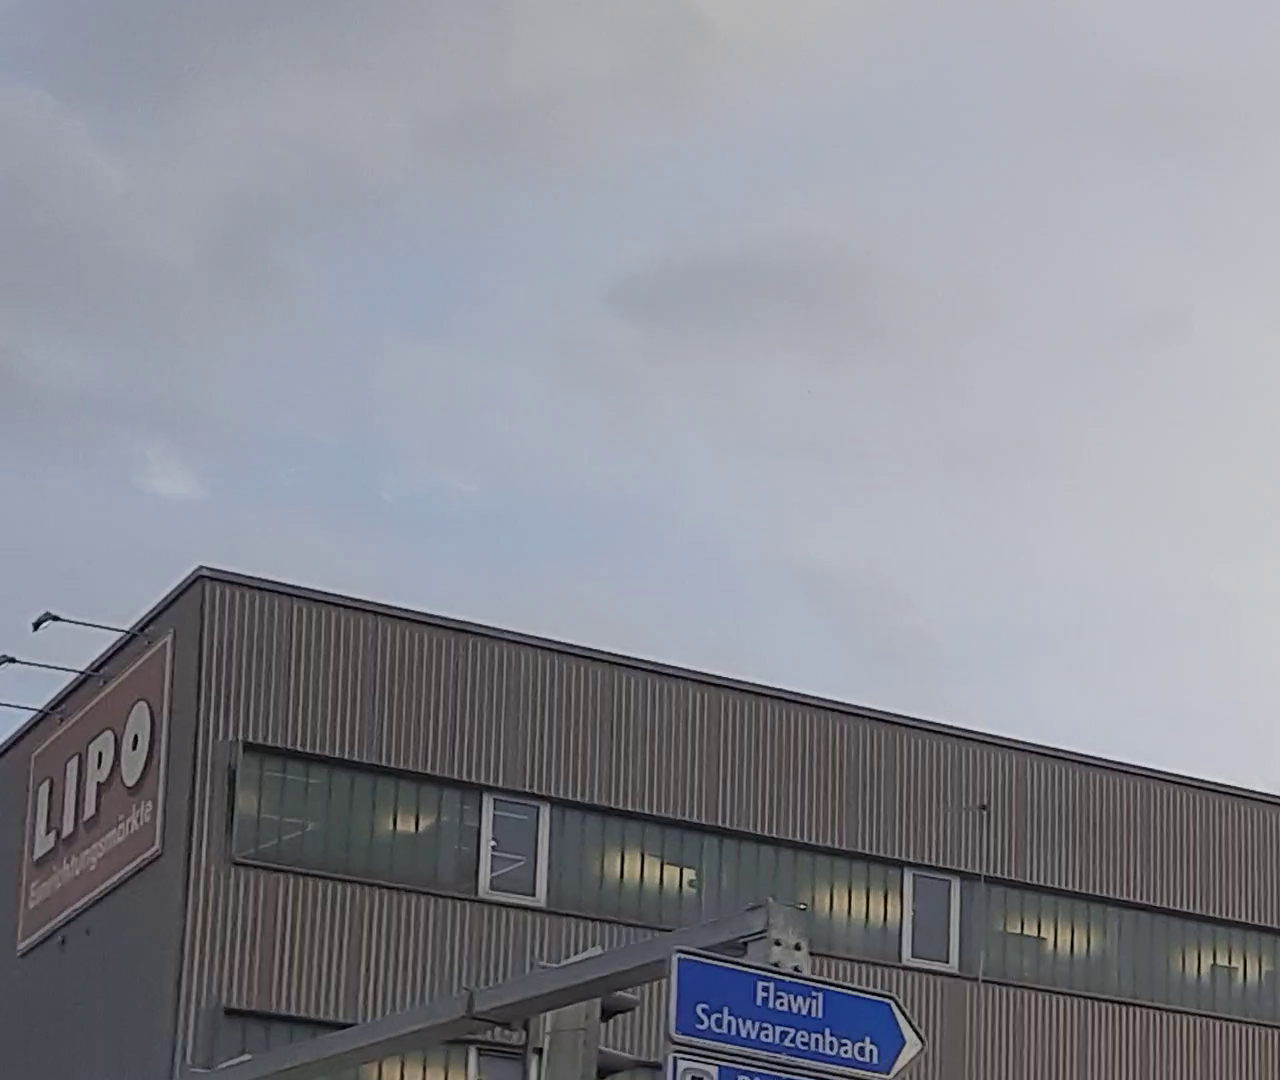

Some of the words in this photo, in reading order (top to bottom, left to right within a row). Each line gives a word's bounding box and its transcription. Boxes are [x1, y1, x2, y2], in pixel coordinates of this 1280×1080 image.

[33, 700, 152, 863] LIPO
[756, 980, 824, 1019] Flawil
[695, 1003, 879, 1065] Schwarzenbach
